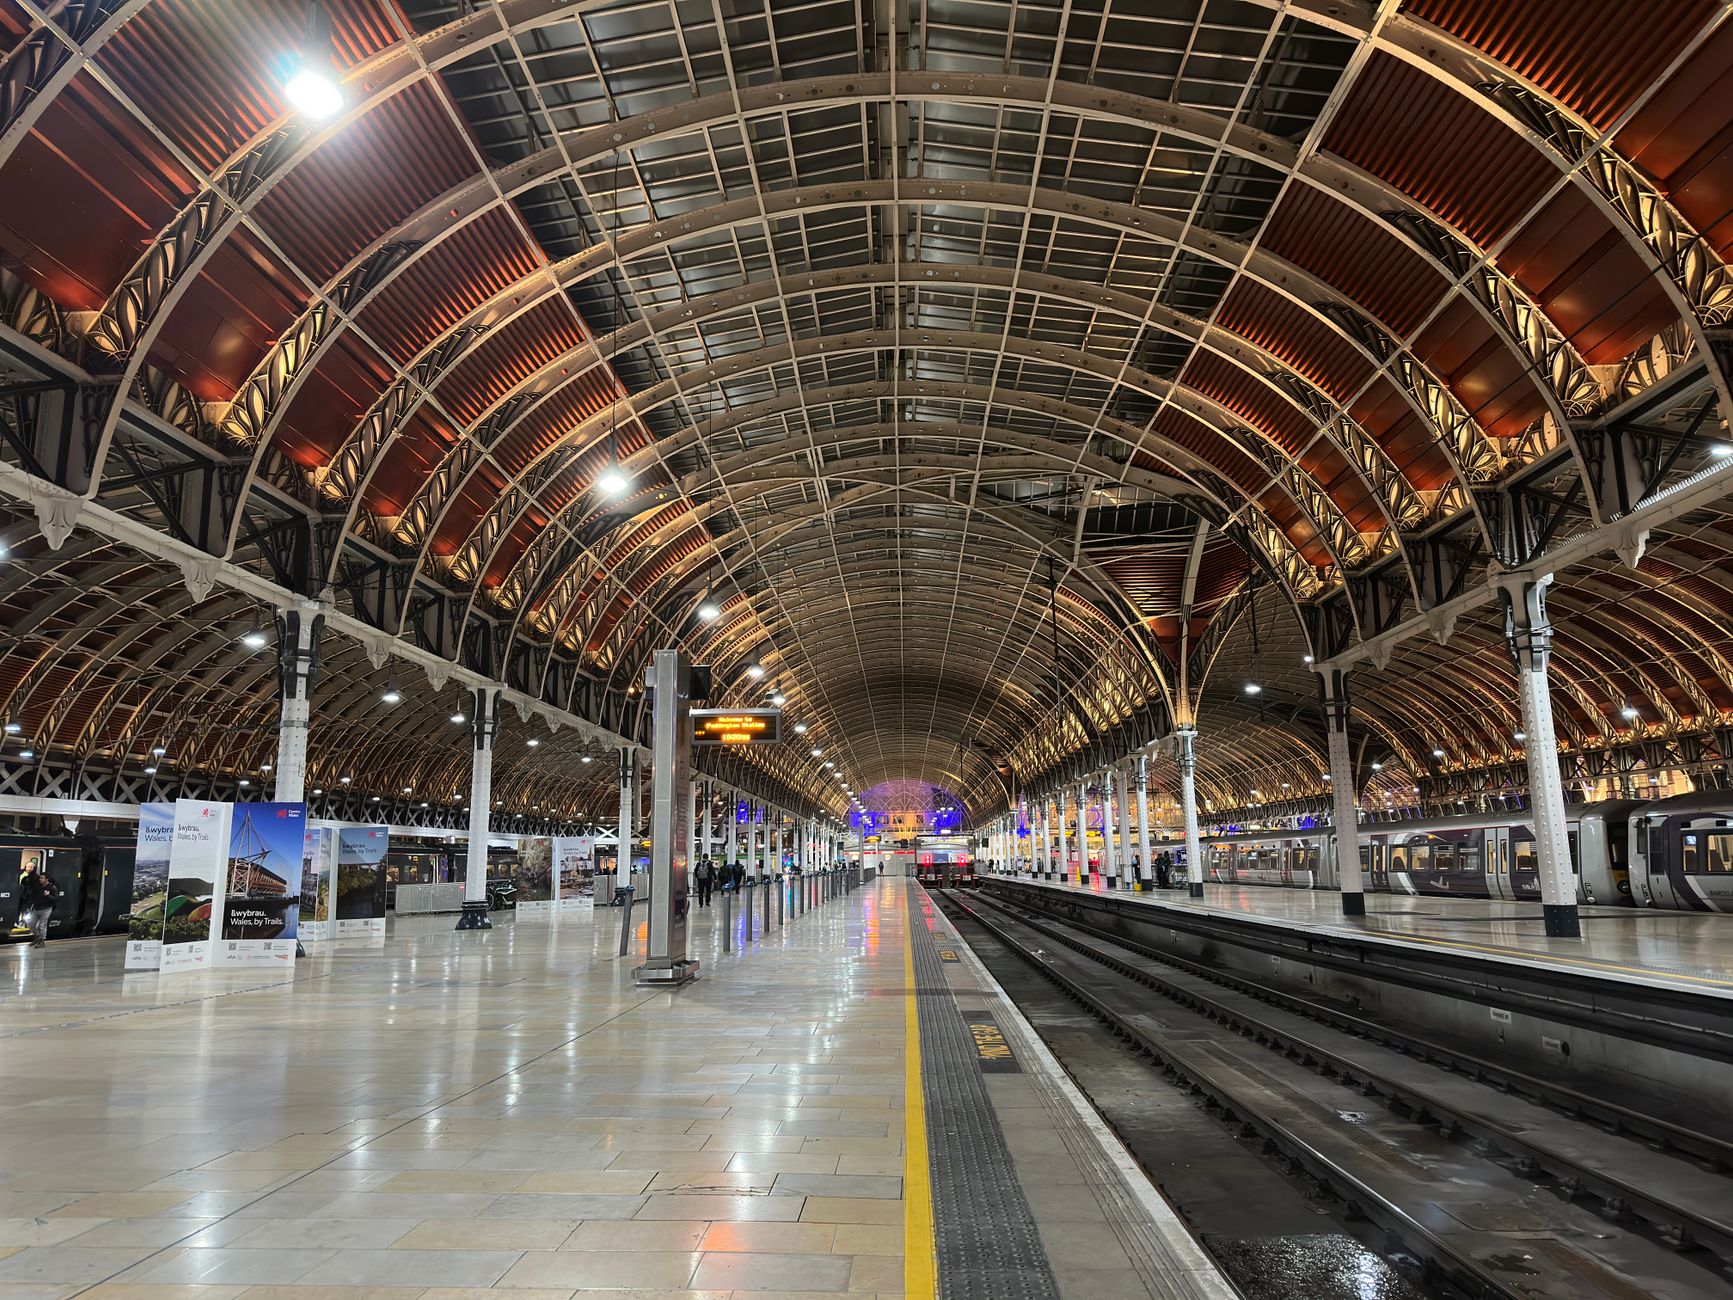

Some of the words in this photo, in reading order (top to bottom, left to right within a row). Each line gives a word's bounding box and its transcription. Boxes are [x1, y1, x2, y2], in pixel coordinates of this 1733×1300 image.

[230, 917, 253, 926] Wales,
[253, 917, 264, 926] by
[264, 917, 284, 925] Trails.
